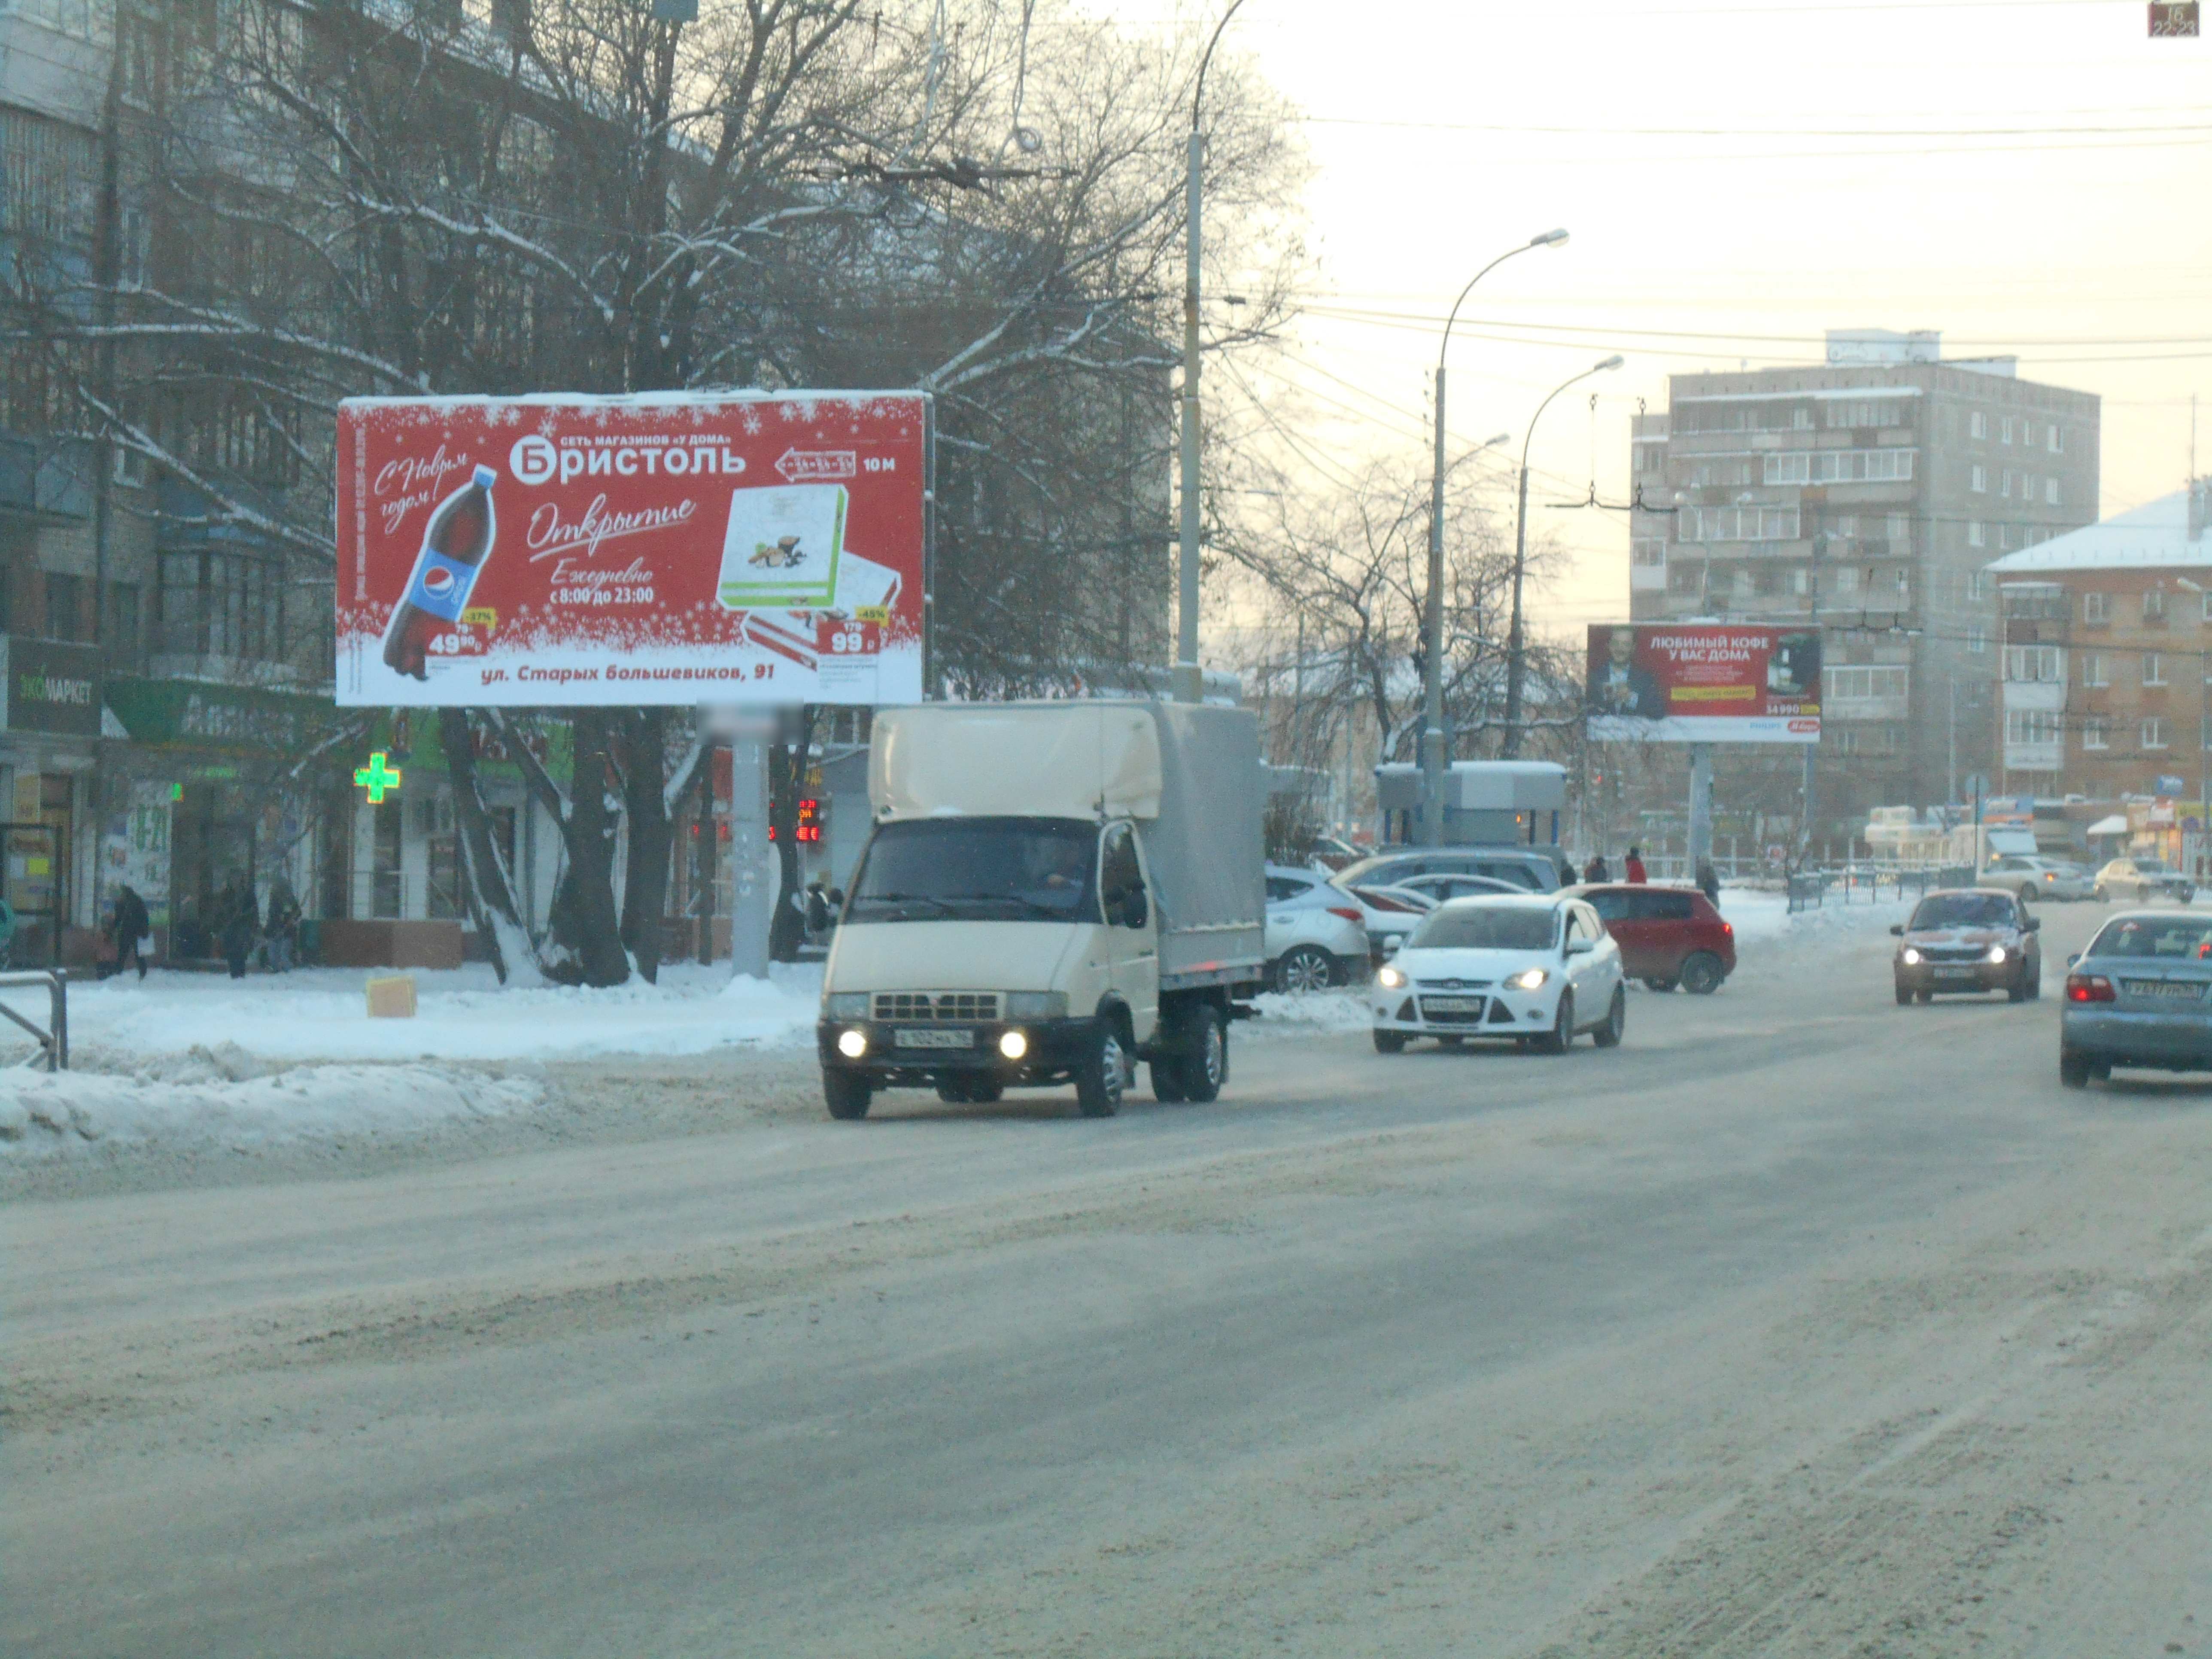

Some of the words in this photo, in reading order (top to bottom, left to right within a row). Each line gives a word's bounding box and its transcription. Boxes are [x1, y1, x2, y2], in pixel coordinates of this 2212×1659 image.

[560, 436, 591, 446] СЕТЬ
[595, 435, 669, 446] МАГАЗИНОВ
[689, 434, 731, 446] ДОМА»
[509, 434, 746, 485] Бристоль
[863, 458, 880, 471] 10
[527, 492, 697, 557] Открытие
[550, 556, 653, 593] Ежедневно
[559, 587, 591, 602] 8:00
[593, 591, 612, 606] до
[614, 586, 654, 602] 23:00
[858, 609, 885, 618] -45%
[429, 633, 459, 653] 49
[831, 632, 863, 653] 99
[1650, 635, 1727, 649] ЛЮБИМЫЙ
[1731, 637, 1769, 649] КОФЕ
[1669, 649, 1677, 660] У
[1680, 649, 1706, 661] ВАС
[1708, 649, 1751, 662] ДОМА
[480, 668, 509, 684] ул.
[517, 665, 599, 685] Старых
[605, 664, 746, 683] большевиков,
[754, 664, 775, 679] 91
